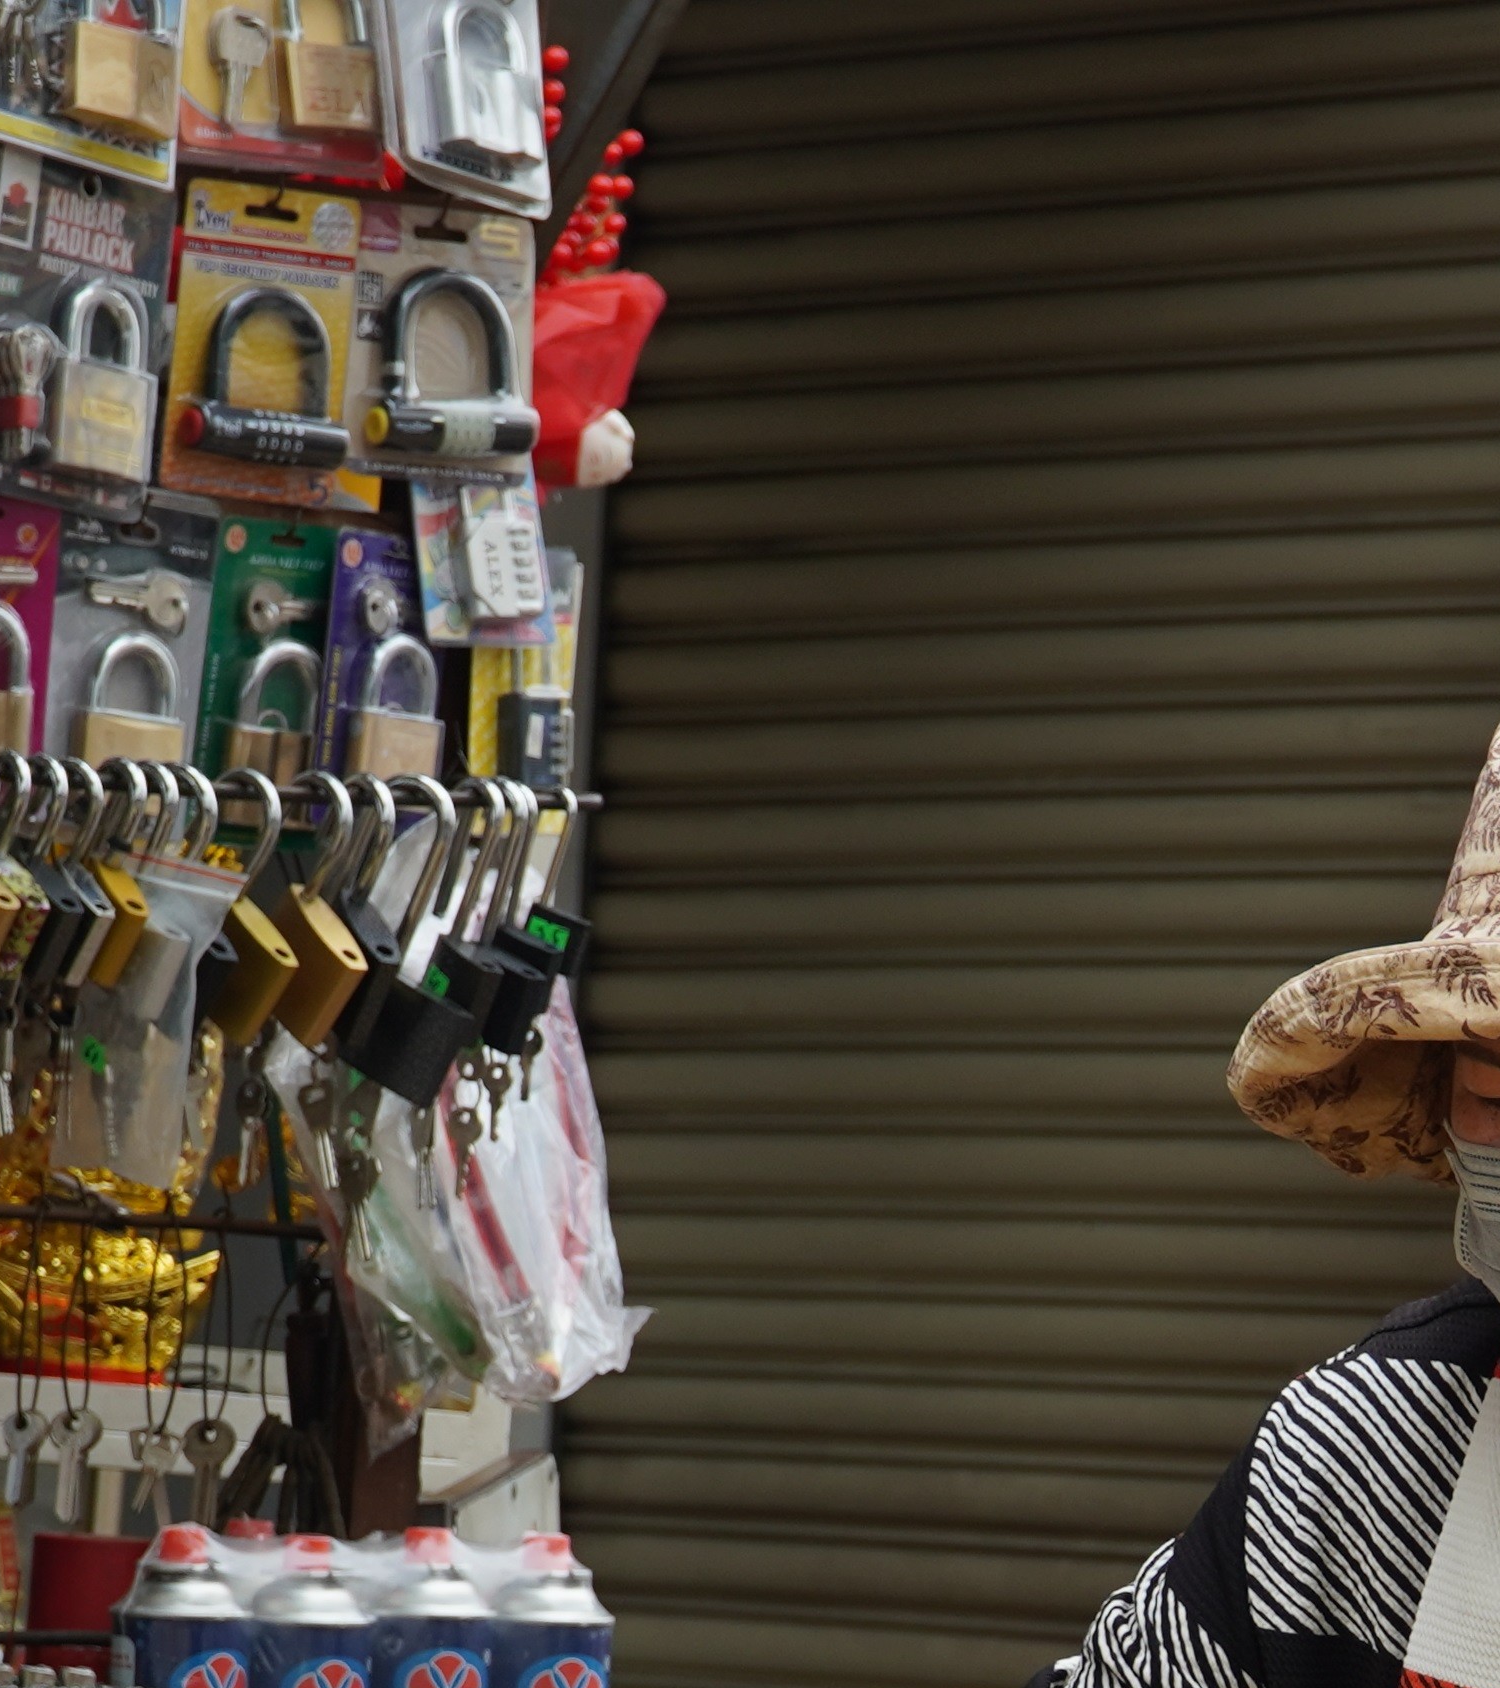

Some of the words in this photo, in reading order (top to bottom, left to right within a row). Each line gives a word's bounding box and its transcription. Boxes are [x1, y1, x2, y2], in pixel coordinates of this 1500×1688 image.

[46, 186, 126, 235] KINBAR
[42, 218, 136, 274] PADLOCK
[220, 262, 278, 281] SECURITY
[484, 539, 505, 597] ALEX
